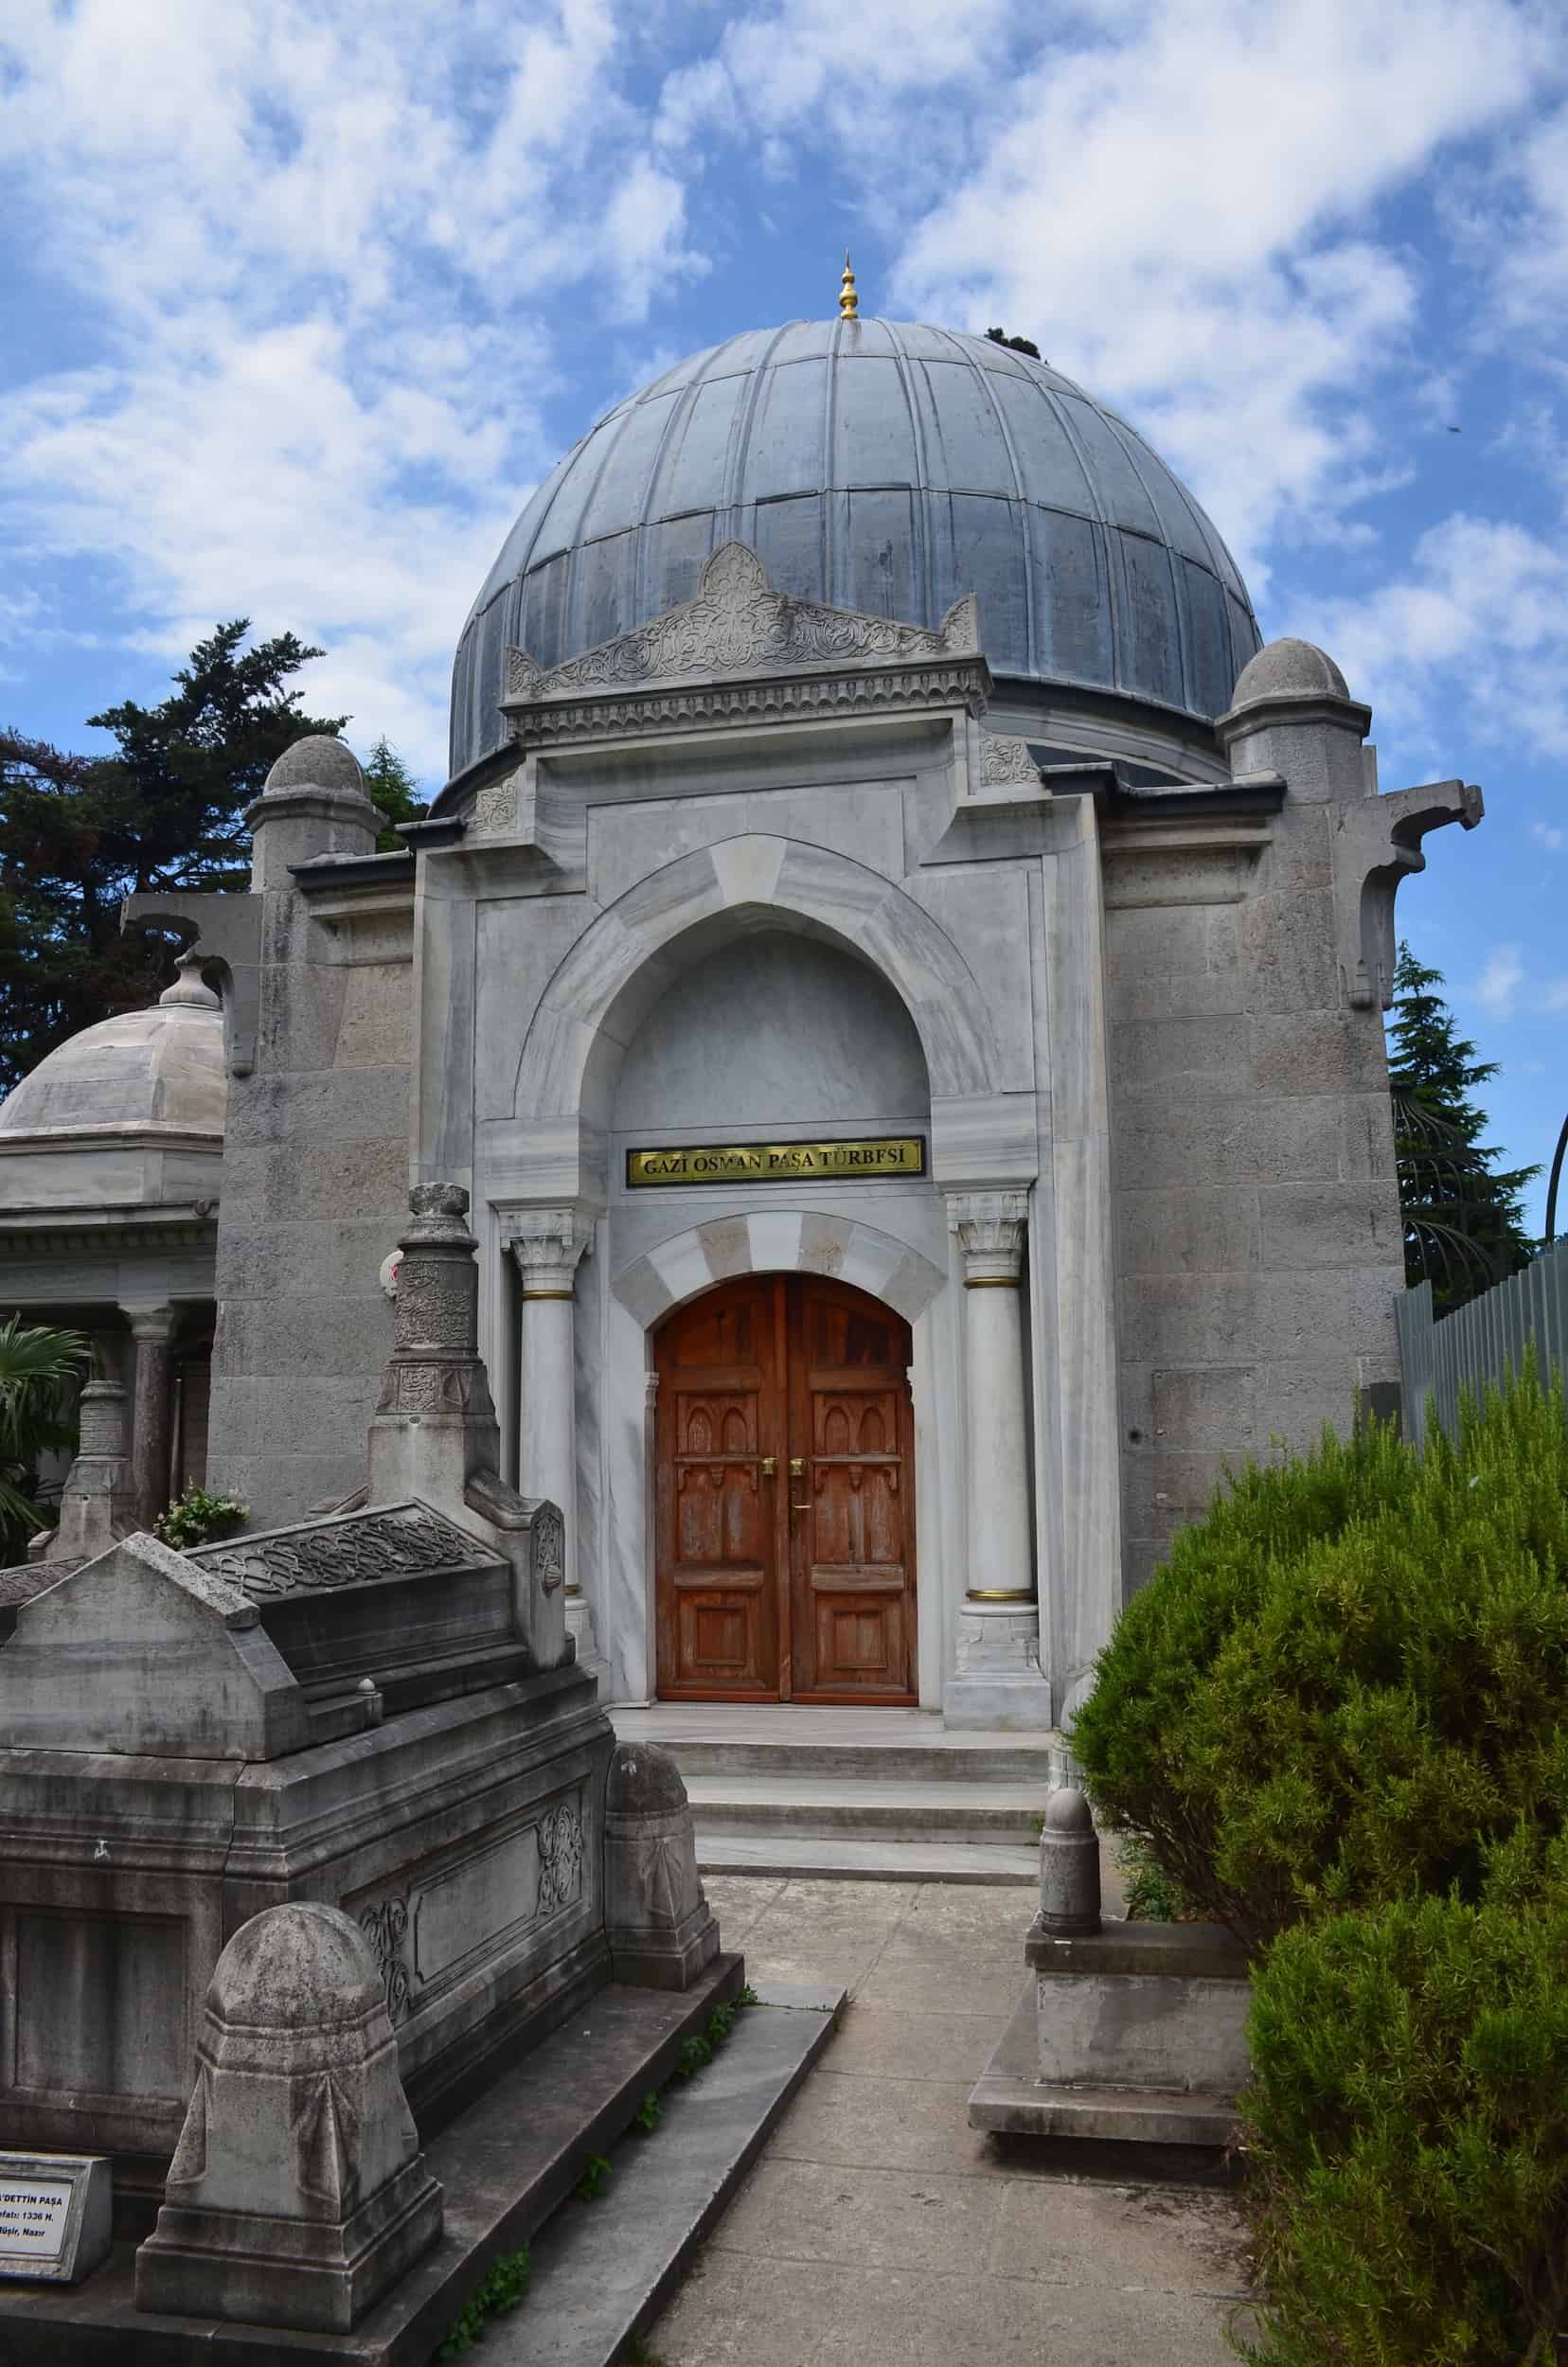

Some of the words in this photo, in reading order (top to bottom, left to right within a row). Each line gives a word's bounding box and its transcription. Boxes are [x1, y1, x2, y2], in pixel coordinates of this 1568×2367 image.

[644, 1154, 687, 1174] GAZİ
[693, 1153, 762, 1172] OSMAN
[768, 1151, 814, 1171] PAŞA
[39, 2197, 62, 2208] PAŞA
